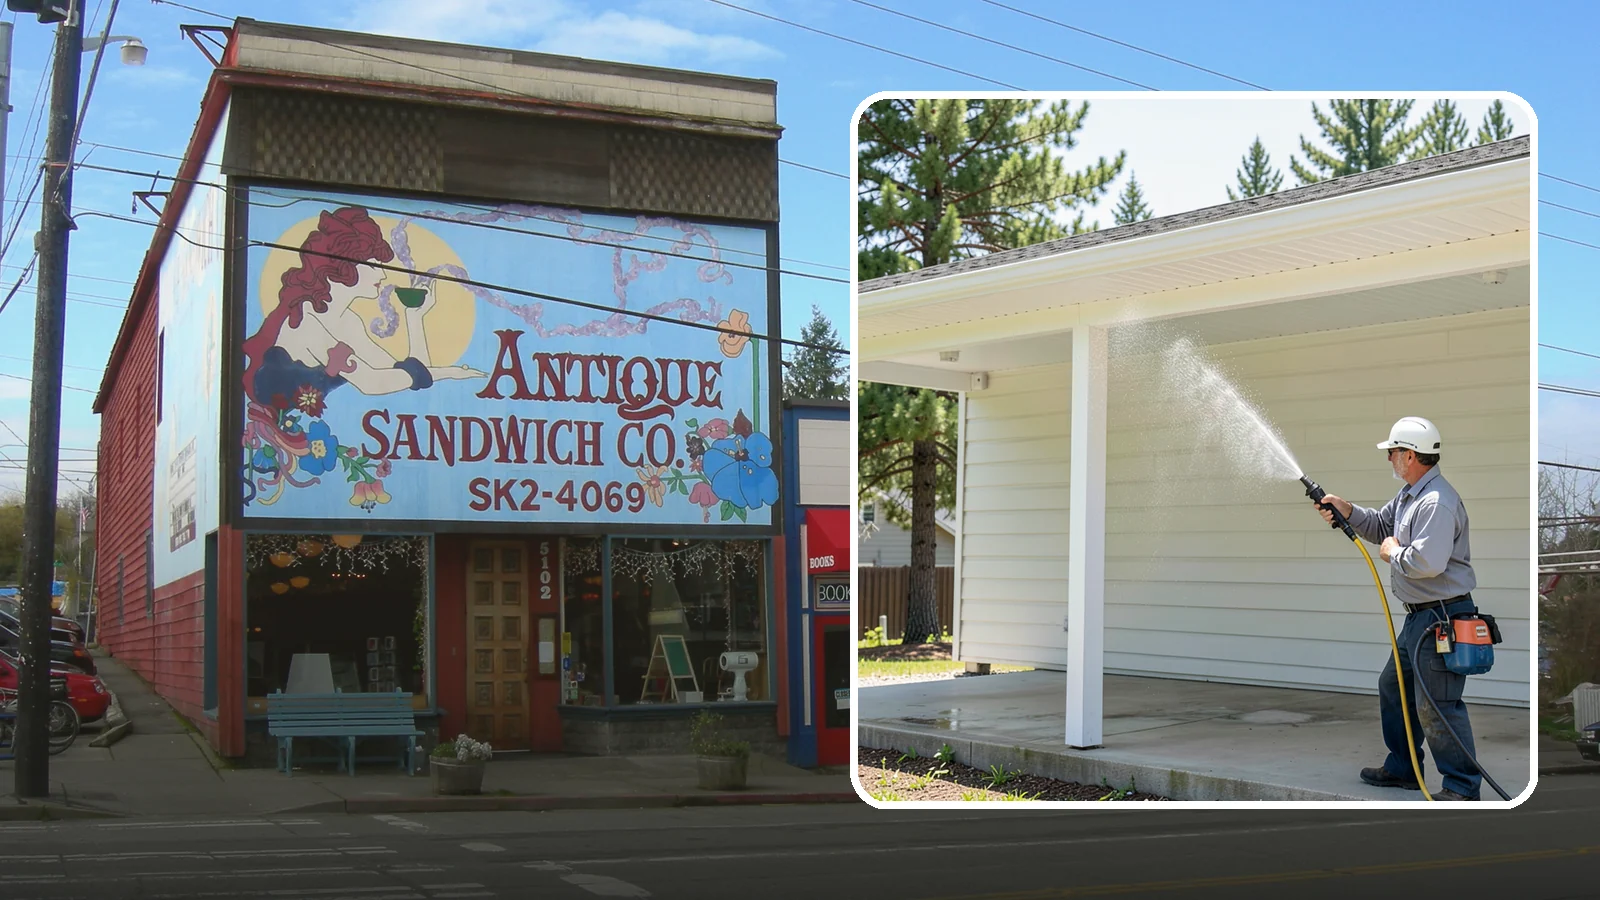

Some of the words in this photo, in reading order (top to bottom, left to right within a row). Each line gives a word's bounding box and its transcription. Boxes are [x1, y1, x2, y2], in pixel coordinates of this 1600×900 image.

[477, 329, 723, 421] ANTIQUE
[361, 409, 604, 466] SANDWICH
[617, 422, 685, 468] CO.
[468, 477, 645, 513] SK2-4069
[540, 541, 551, 599] 5102
[809, 555, 835, 569] BOOKS
